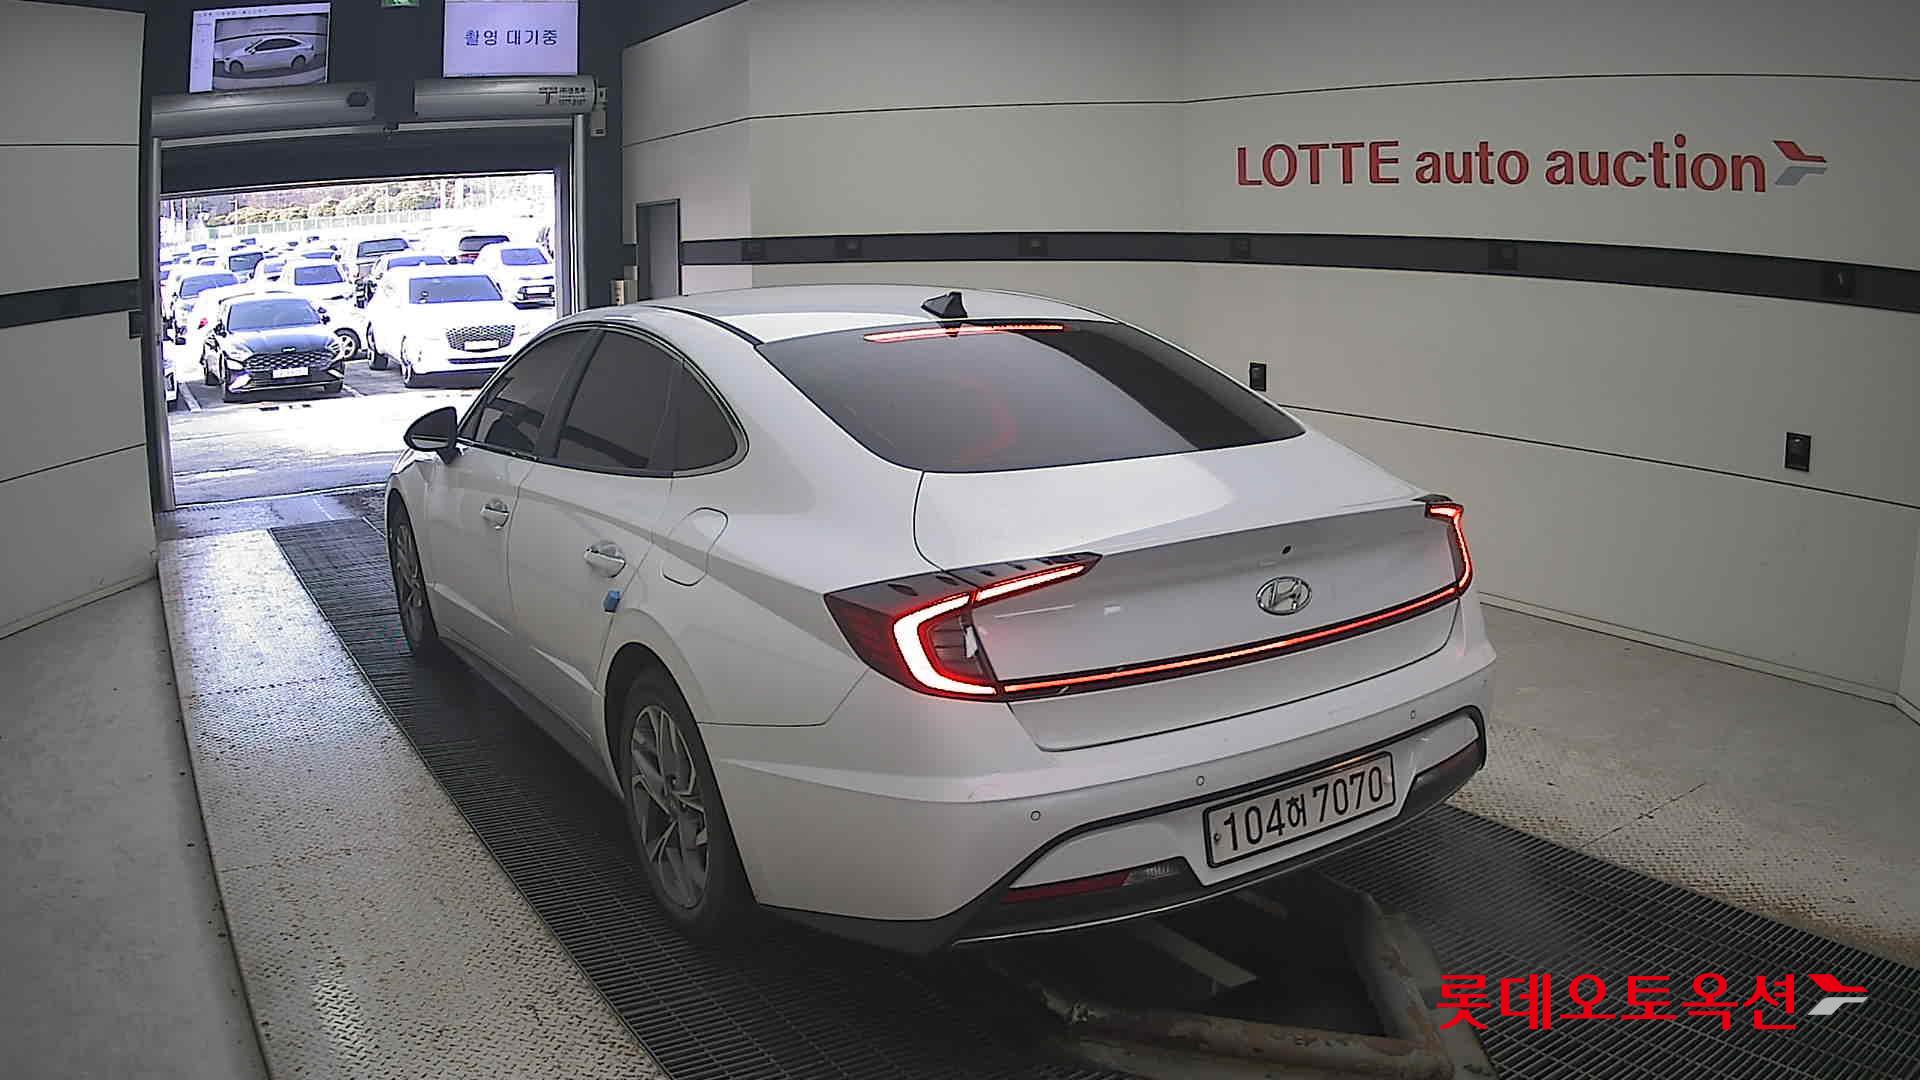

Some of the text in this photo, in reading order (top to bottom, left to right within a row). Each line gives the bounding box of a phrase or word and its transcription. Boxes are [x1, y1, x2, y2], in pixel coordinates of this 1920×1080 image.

[506, 29, 558, 46] 대기중
[1237, 134, 1766, 193] LOTTE auto auction
